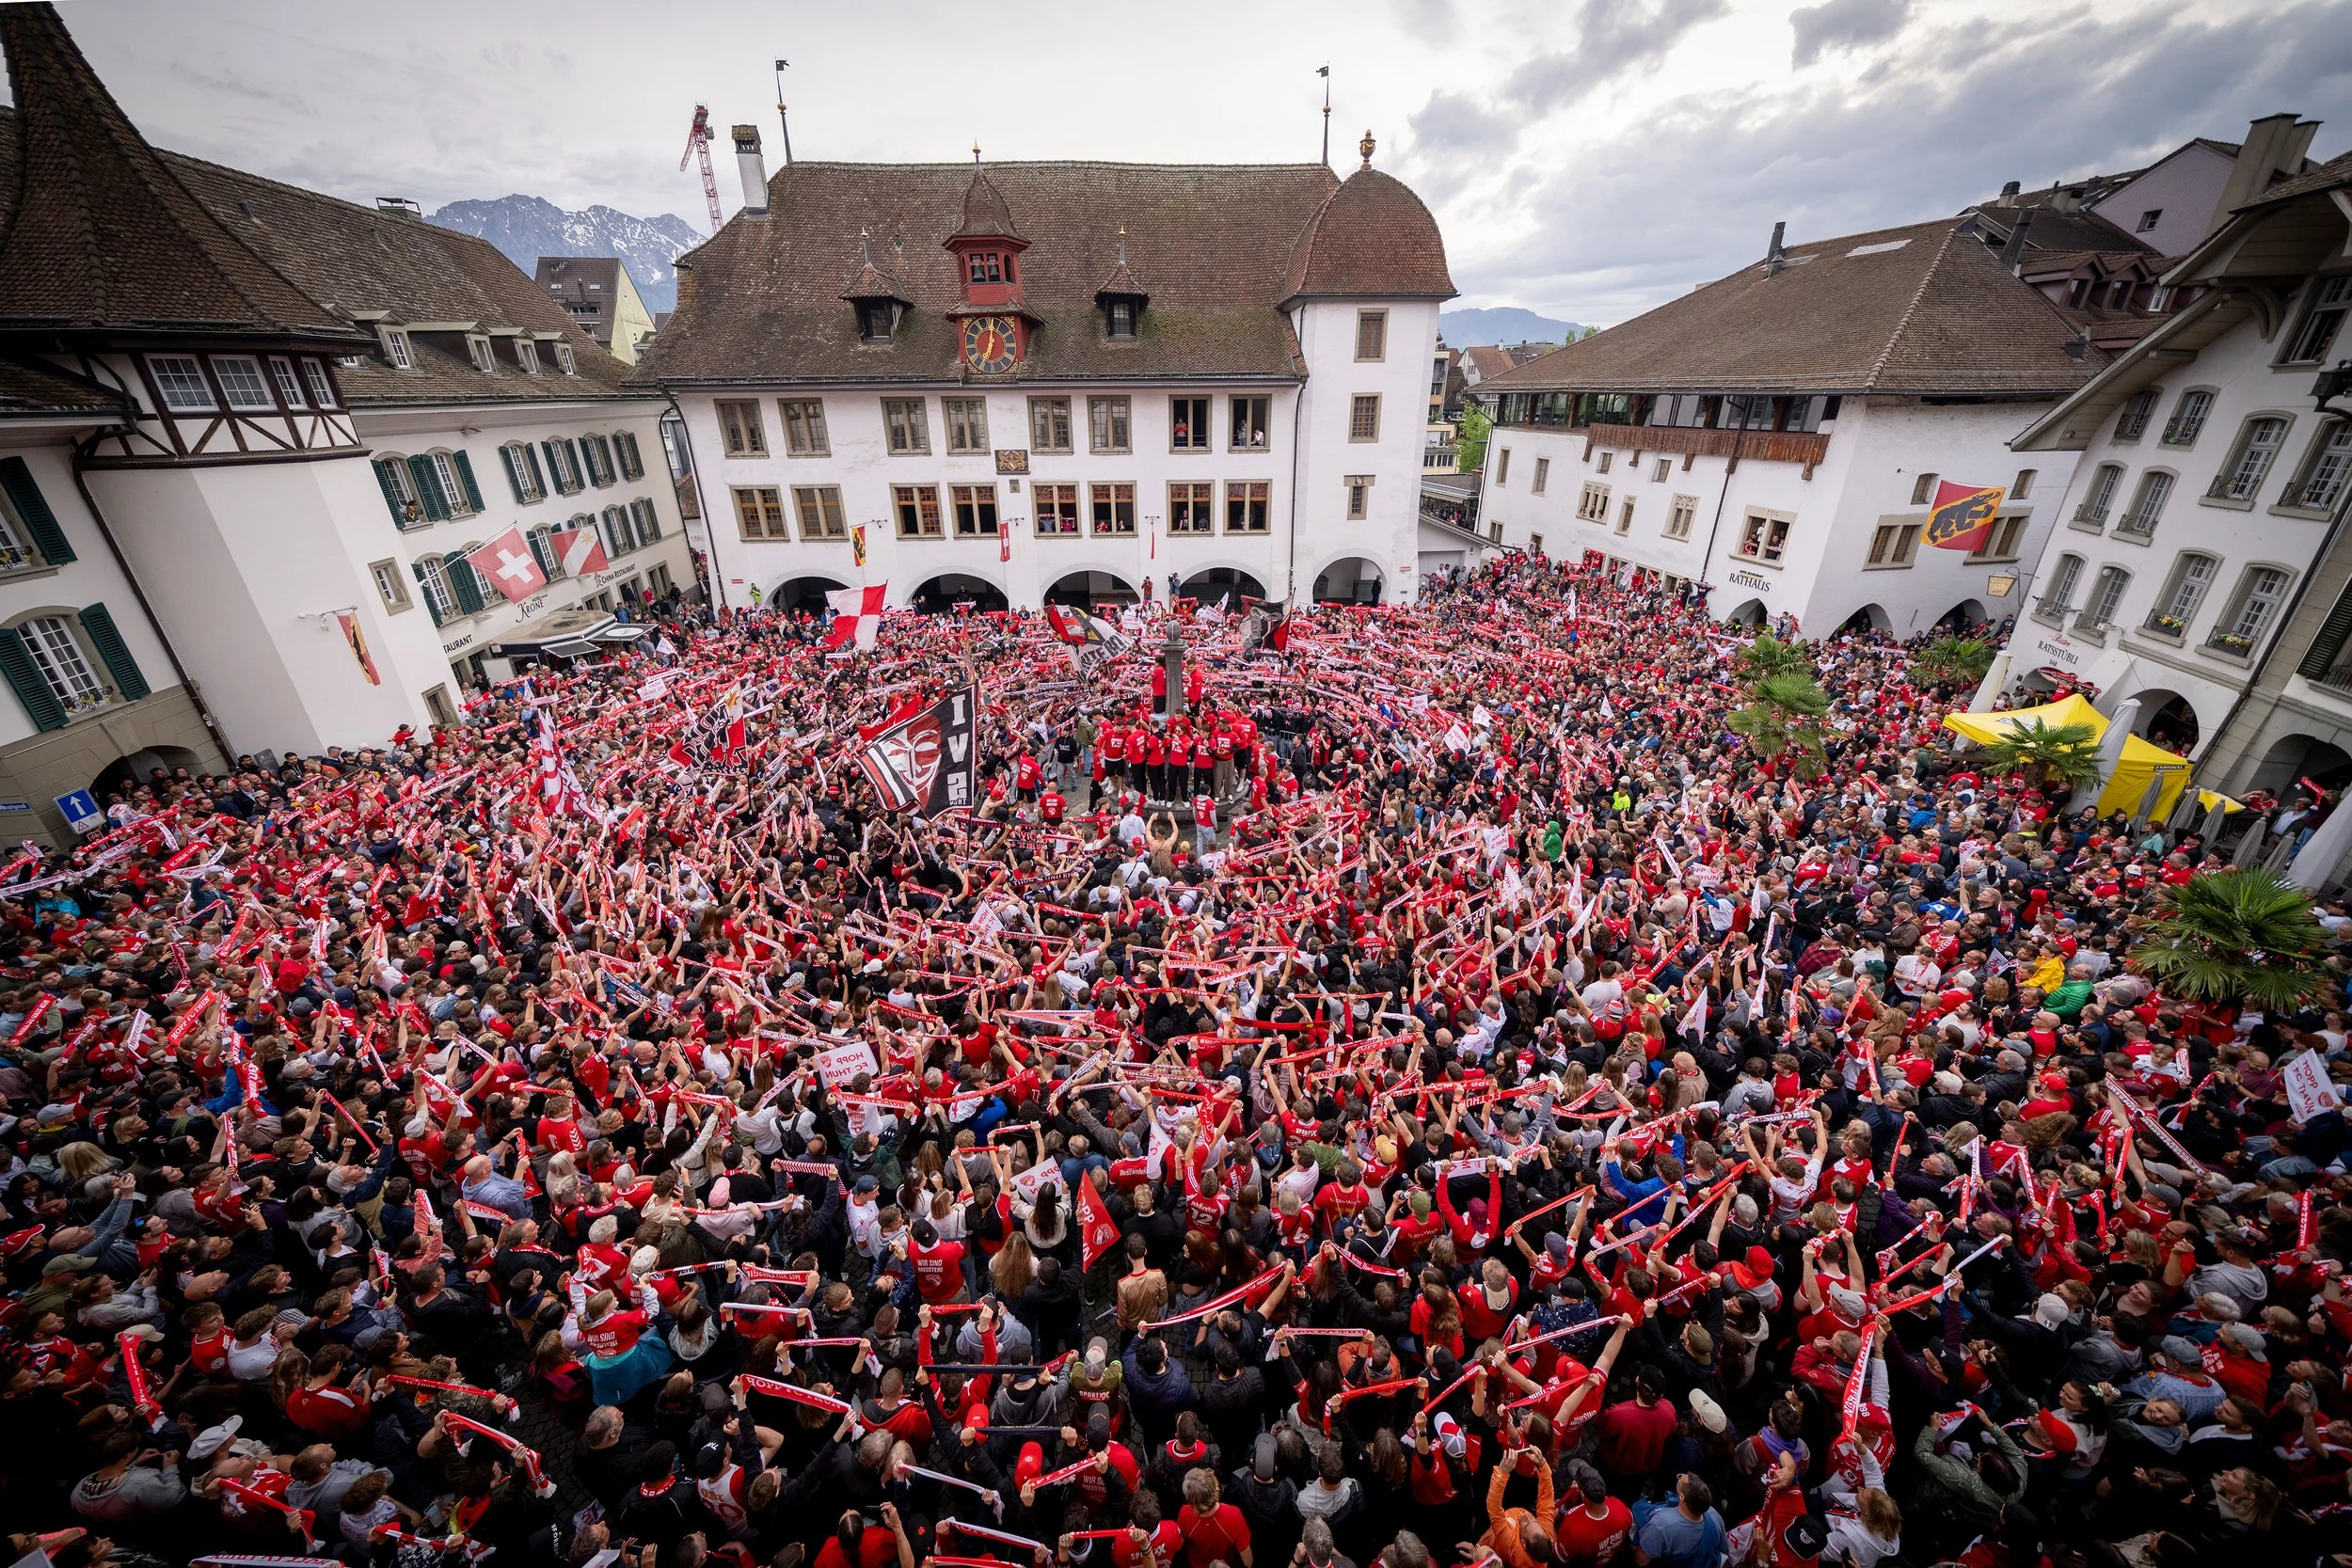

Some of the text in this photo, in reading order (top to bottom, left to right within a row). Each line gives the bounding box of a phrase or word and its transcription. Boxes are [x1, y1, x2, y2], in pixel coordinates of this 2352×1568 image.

[601, 564, 636, 585] CHINA RESTAURANT
[1729, 573, 1771, 592] RATHAUS
[516, 599, 544, 623] KRONE
[2052, 634, 2072, 647] Bistro
[2038, 641, 2078, 665] RATSSTÜBLI
[171, 995, 210, 1039] HOPP FC THUN
[2302, 1059, 2318, 1090] HOPP
[2293, 1067, 2302, 1083] FC
[2298, 1083, 2315, 1114] THUN
[1466, 1097, 1486, 1108] THU
[916, 1259, 929, 1267] WIR
[746, 1376, 780, 1392] HOPP
[1083, 1475, 1096, 1484] WIR
